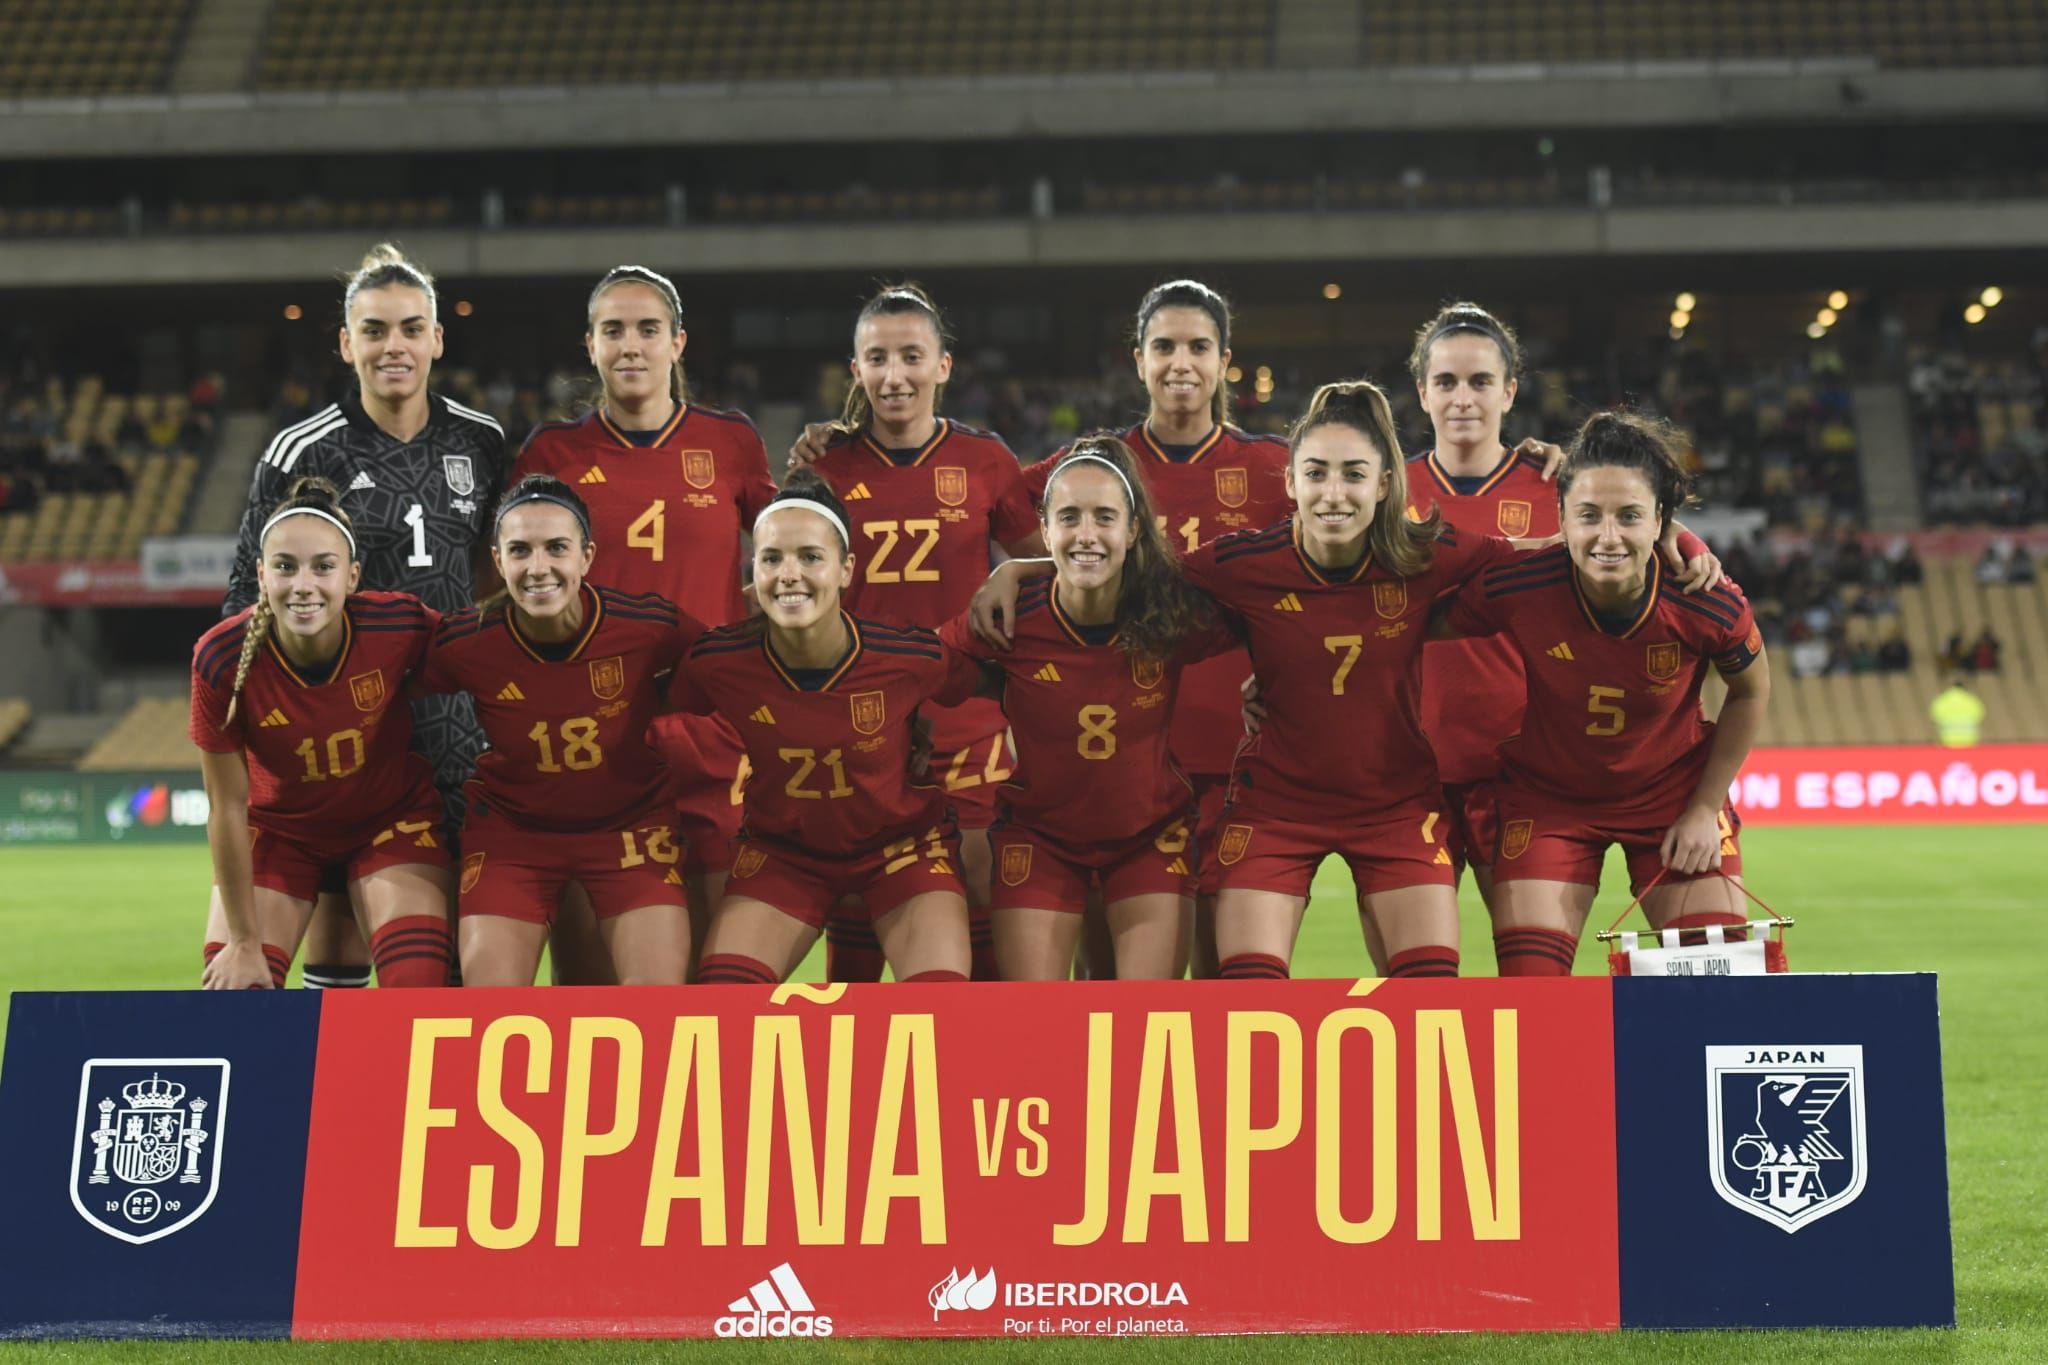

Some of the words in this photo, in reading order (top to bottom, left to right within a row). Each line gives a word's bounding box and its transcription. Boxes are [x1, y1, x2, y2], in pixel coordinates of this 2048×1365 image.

[403, 504, 434, 568] 1
[626, 499, 666, 562] 4
[864, 519, 940, 584] 22
[1323, 635, 1363, 697] 7
[1077, 704, 1117, 761] 8
[1587, 685, 1626, 736] 5
[295, 728, 366, 779] 10
[528, 716, 603, 772] 18
[778, 747, 854, 799] 21
[1666, 960, 1694, 976] SPAIN
[1744, 1051, 1825, 1064] JAPAN
[394, 981, 947, 1250] ESPAÑA
[1053, 975, 1522, 1247] JAPÓN
[1751, 1170, 1828, 1200] JFA
[1005, 1282, 1189, 1306] IBERDROLA
[713, 1310, 834, 1338] adidas
[1004, 1318, 1034, 1334] Por
[1038, 1317, 1056, 1333] ti.
[1061, 1318, 1091, 1333] Por
[1095, 1317, 1111, 1333] el
[1116, 1317, 1189, 1337] planeta.
